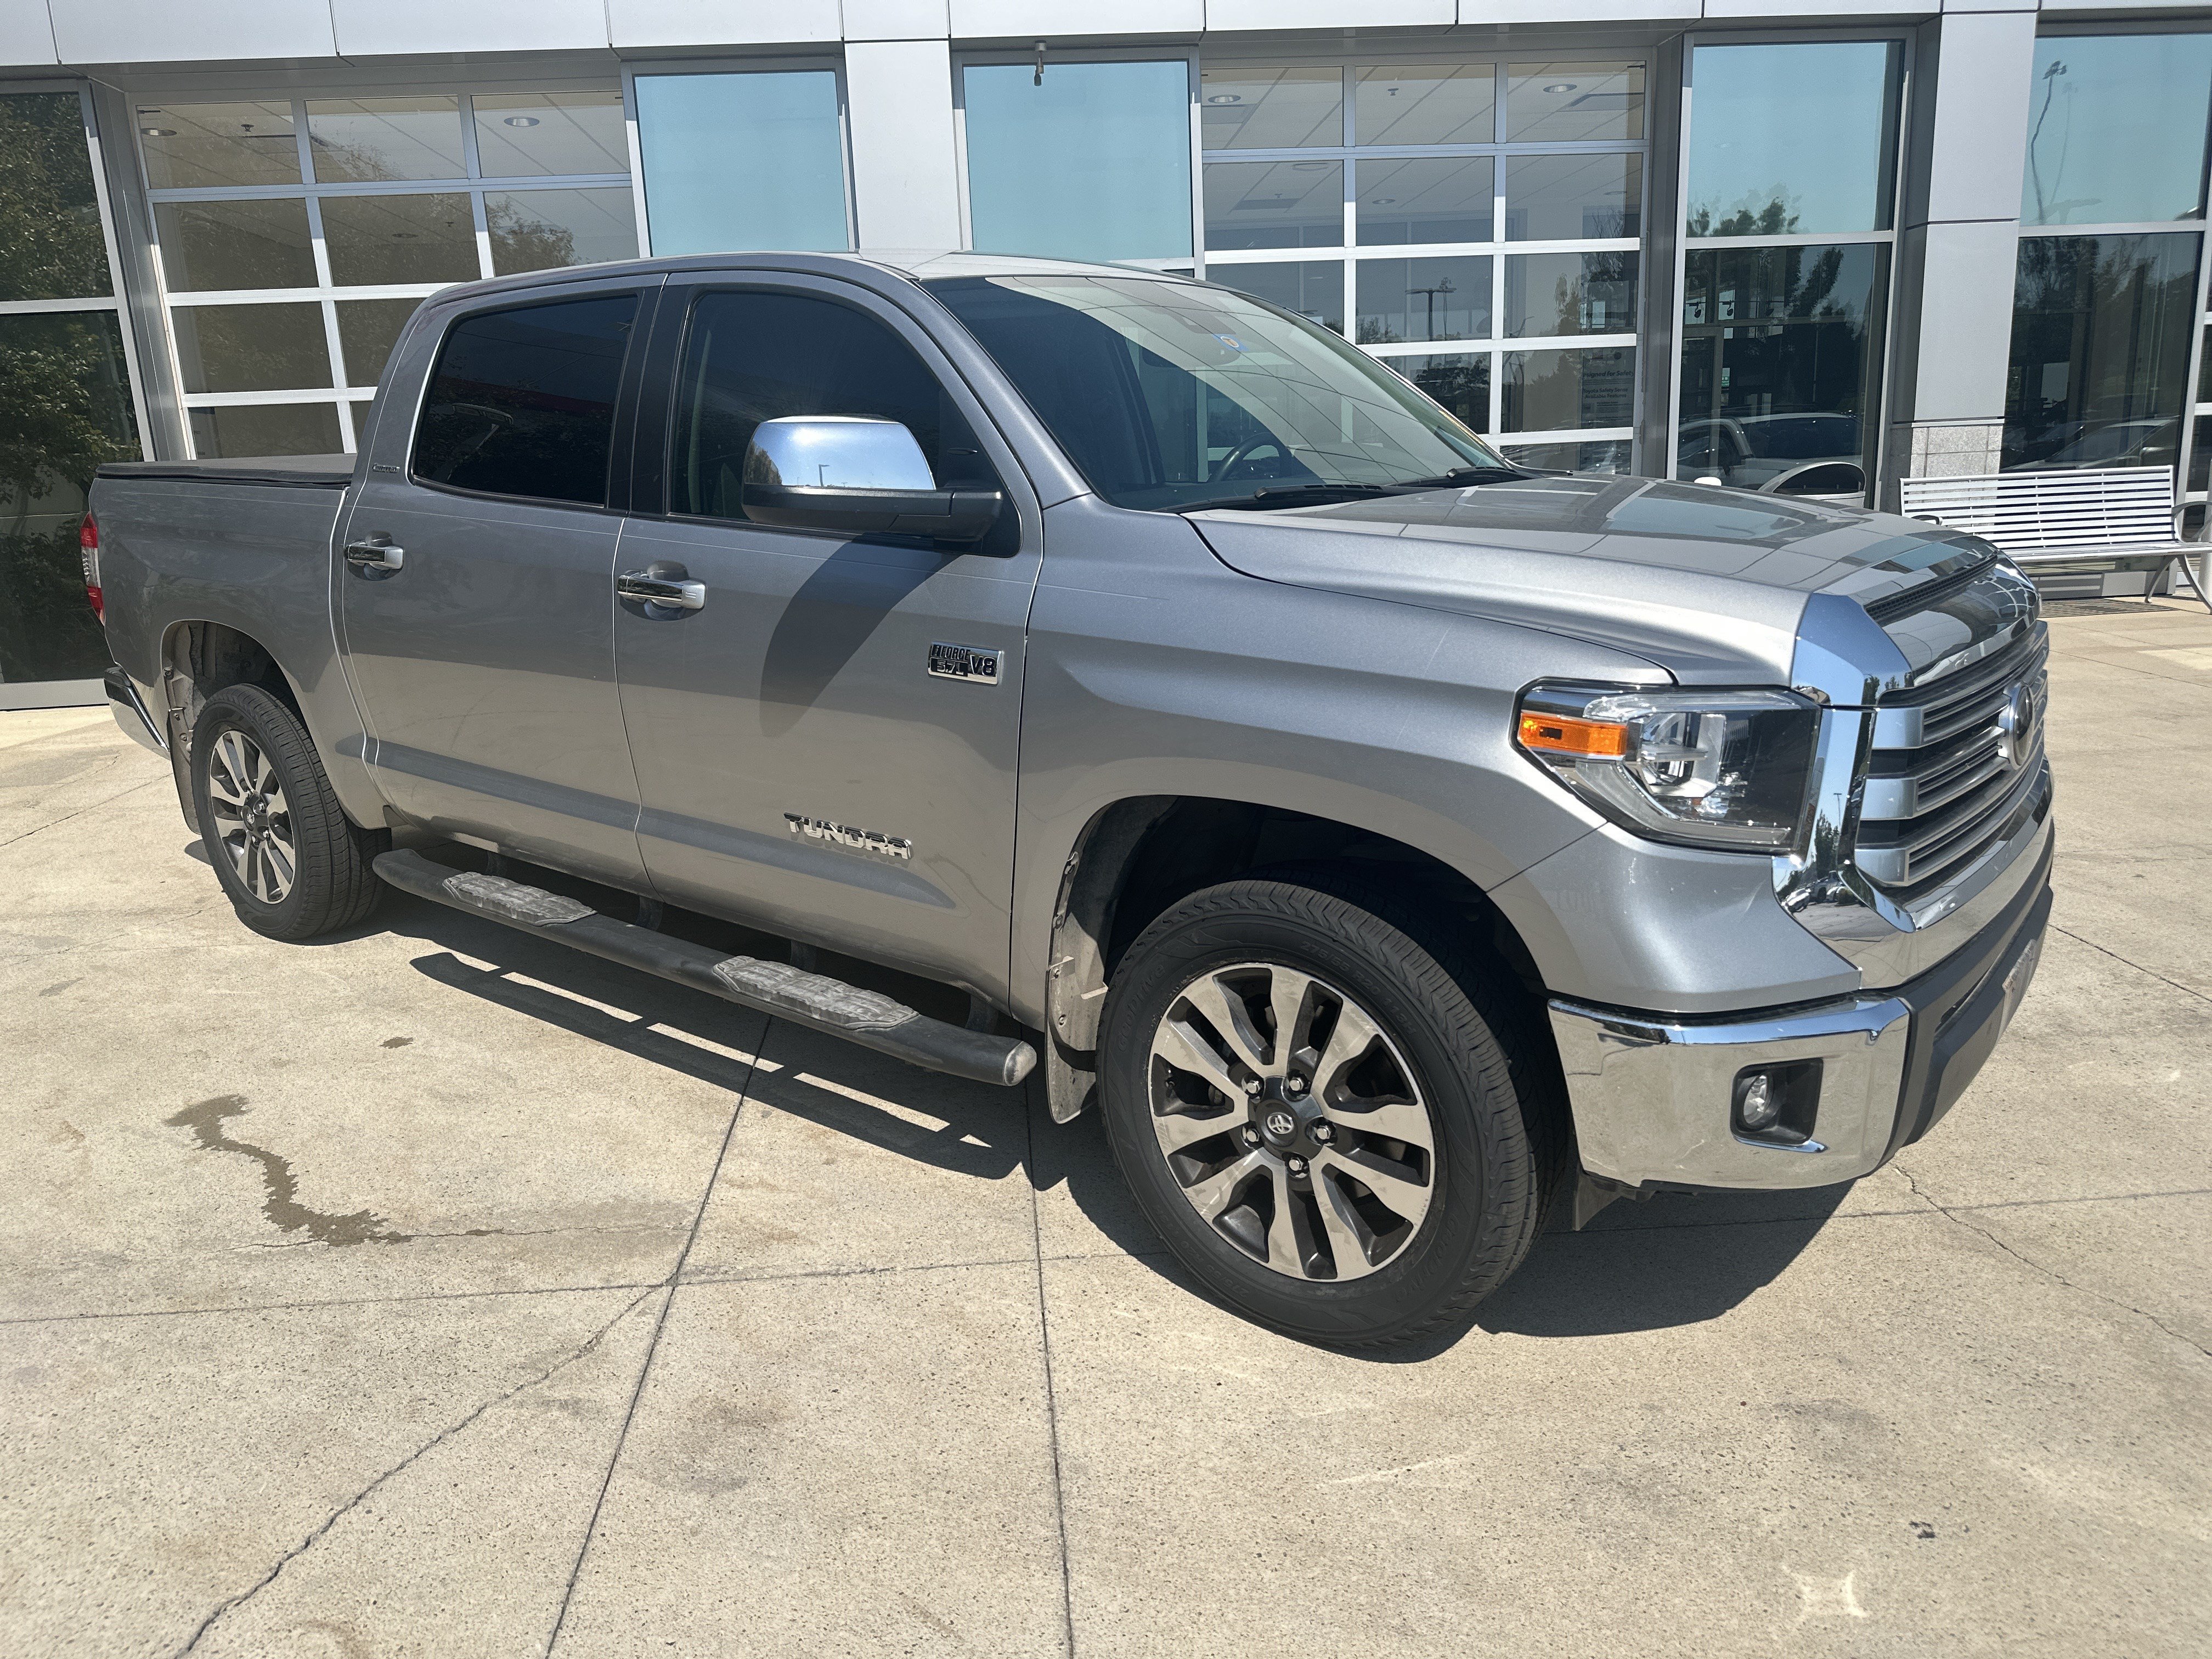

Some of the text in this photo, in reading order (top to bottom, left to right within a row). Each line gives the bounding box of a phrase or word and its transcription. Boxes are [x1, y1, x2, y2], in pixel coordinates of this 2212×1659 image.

[969, 654, 996, 678] V8
[783, 812, 913, 860] TUNDRA
[1299, 941, 1351, 973] 275/55
